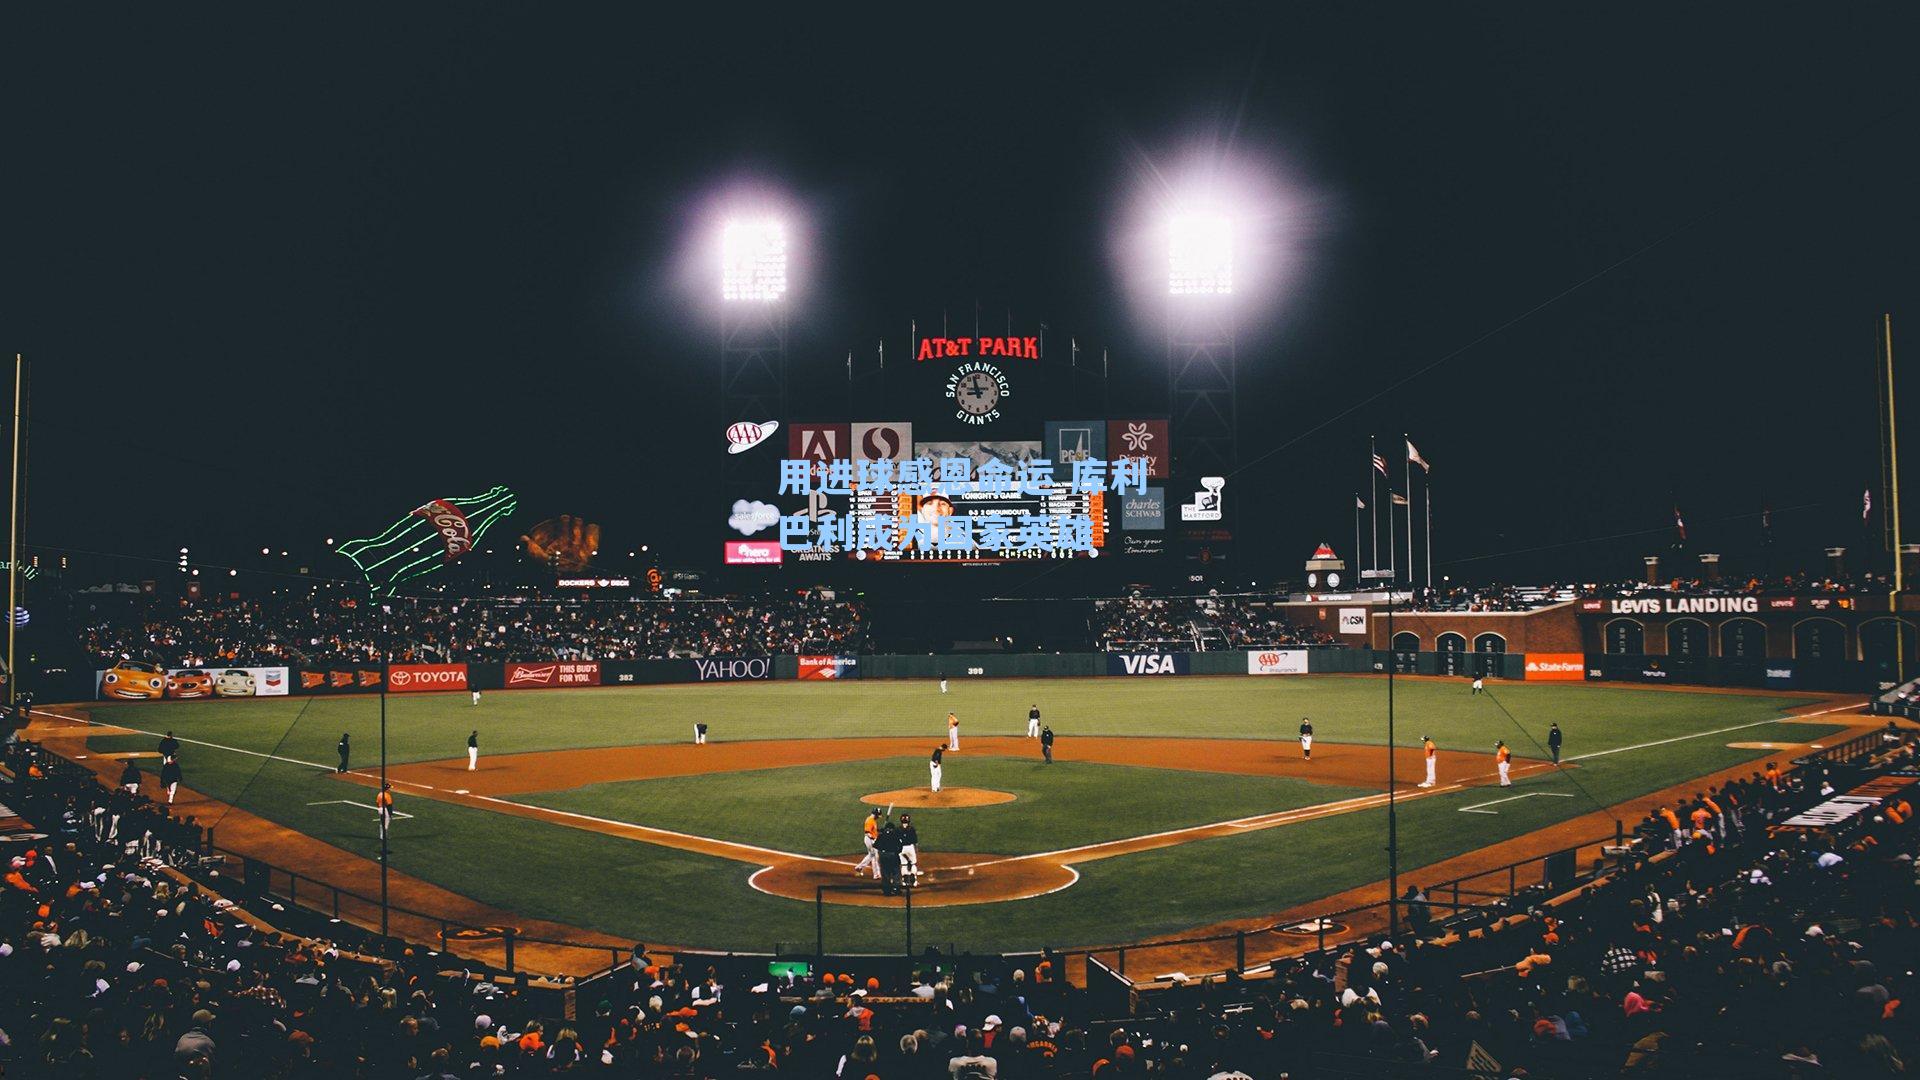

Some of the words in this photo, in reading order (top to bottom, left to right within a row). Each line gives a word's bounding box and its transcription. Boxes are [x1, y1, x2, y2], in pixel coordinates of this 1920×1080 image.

[917, 337, 972, 360] AT&T
[979, 336, 1038, 359] PARK
[945, 374, 960, 398] SAN
[958, 361, 1010, 397] FRANCISCO
[956, 409, 1000, 425] GIANTS
[961, 492, 999, 500] TONIGHT'S
[1125, 499, 1160, 509] charles
[1125, 510, 1161, 518] SCHWAB
[799, 553, 832, 561] AWAITS
[558, 579, 596, 587] DOCKERS
[610, 579, 630, 587] DECK
[1666, 597, 1759, 613] LANDING
[1349, 616, 1364, 625] CSN
[800, 657, 819, 666] Bank
[819, 657, 826, 665] of
[825, 657, 857, 666] America
[1118, 654, 1176, 674] VISA
[1258, 653, 1280, 666] AAA
[559, 665, 575, 673] THIS
[576, 664, 598, 673] BUD'S
[695, 657, 771, 681] YAHOO!
[412, 671, 467, 683] TOYOTA
[514, 671, 551, 679] Budweiser
[559, 673, 574, 682] FOR
[574, 673, 590, 682] YOU.
